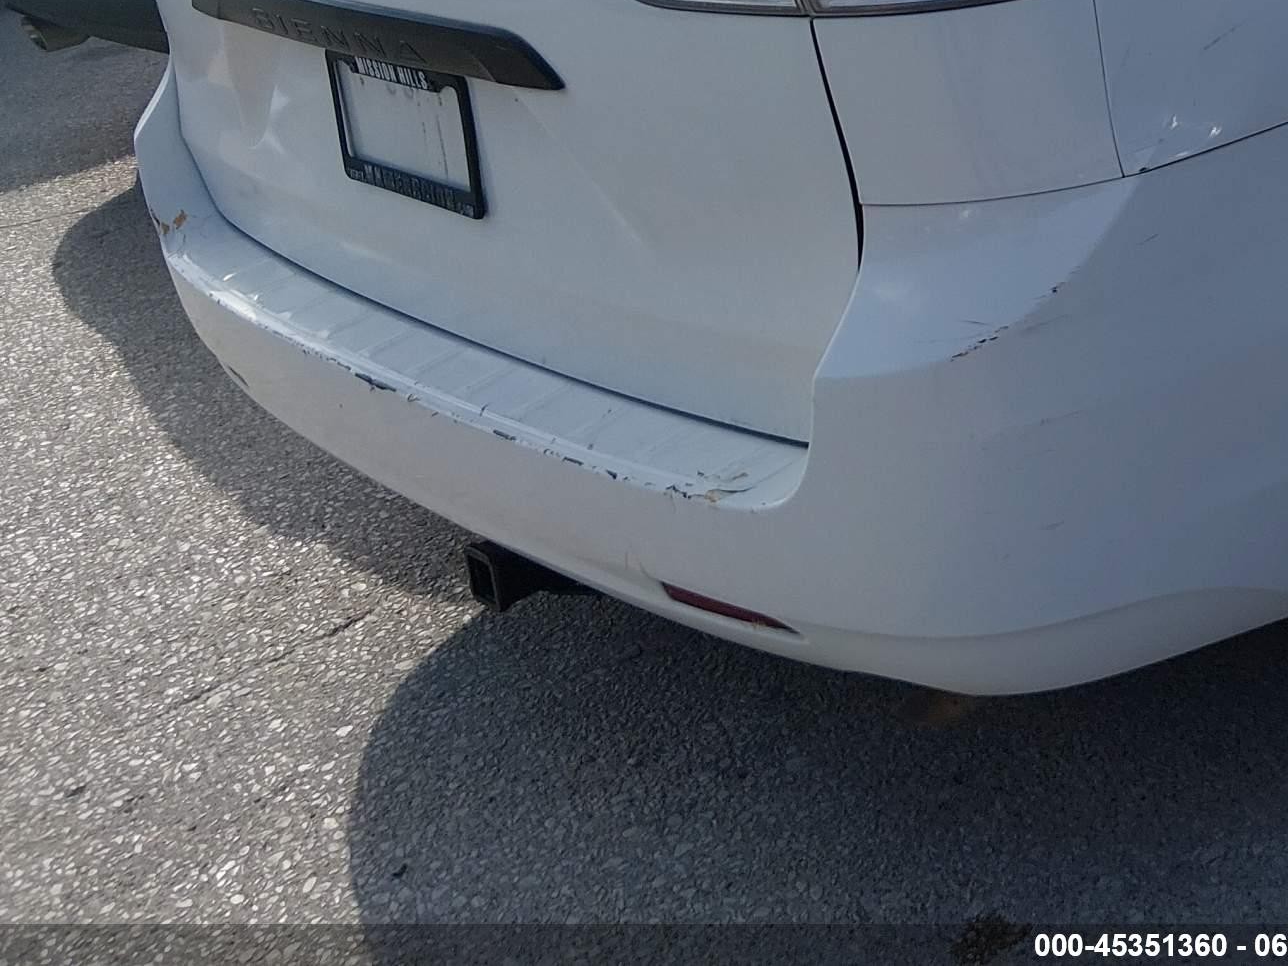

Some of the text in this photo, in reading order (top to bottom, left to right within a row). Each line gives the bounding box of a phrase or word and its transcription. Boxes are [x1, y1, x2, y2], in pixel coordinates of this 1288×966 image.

[251, 7, 428, 64] SIENNA
[355, 56, 428, 90] MISSION HILLS
